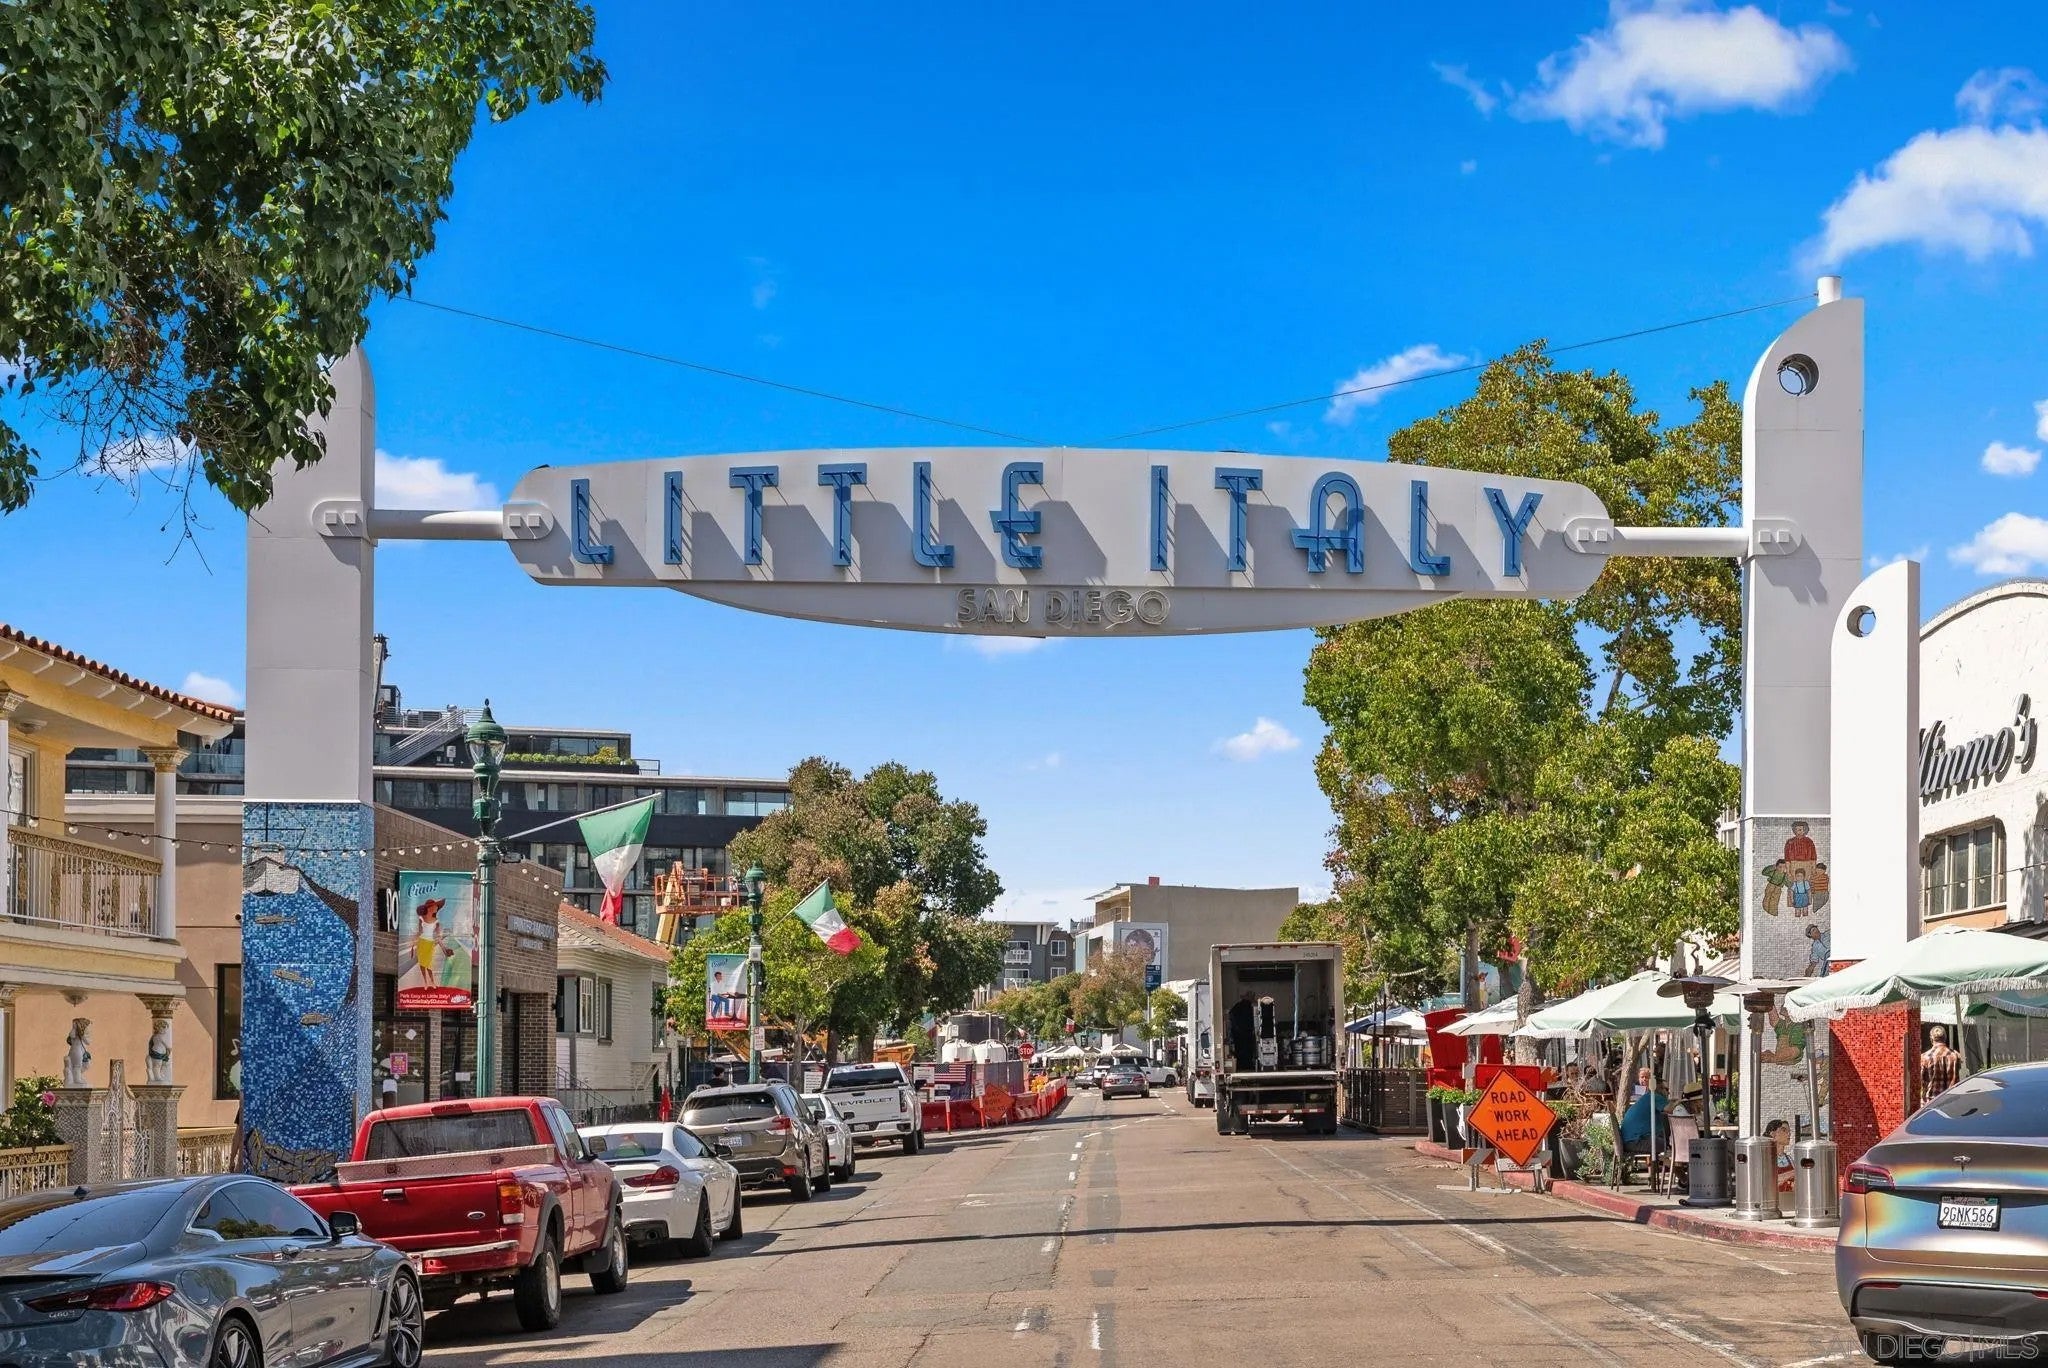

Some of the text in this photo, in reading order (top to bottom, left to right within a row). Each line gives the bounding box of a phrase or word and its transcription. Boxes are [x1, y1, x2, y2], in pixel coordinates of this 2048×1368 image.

[571, 462, 1543, 577] LITTLE ITALY
[957, 588, 1171, 627] SAN DIEGO
[407, 880, 439, 898] Ciao!
[1019, 1047, 1034, 1055] STOP
[833, 1097, 893, 1106] HEVROLET
[1491, 1091, 1526, 1104] ROAD
[1494, 1109, 1531, 1122] WORK
[1496, 1128, 1538, 1141] AHEAD
[1943, 1206, 1994, 1223] 9GNK586
